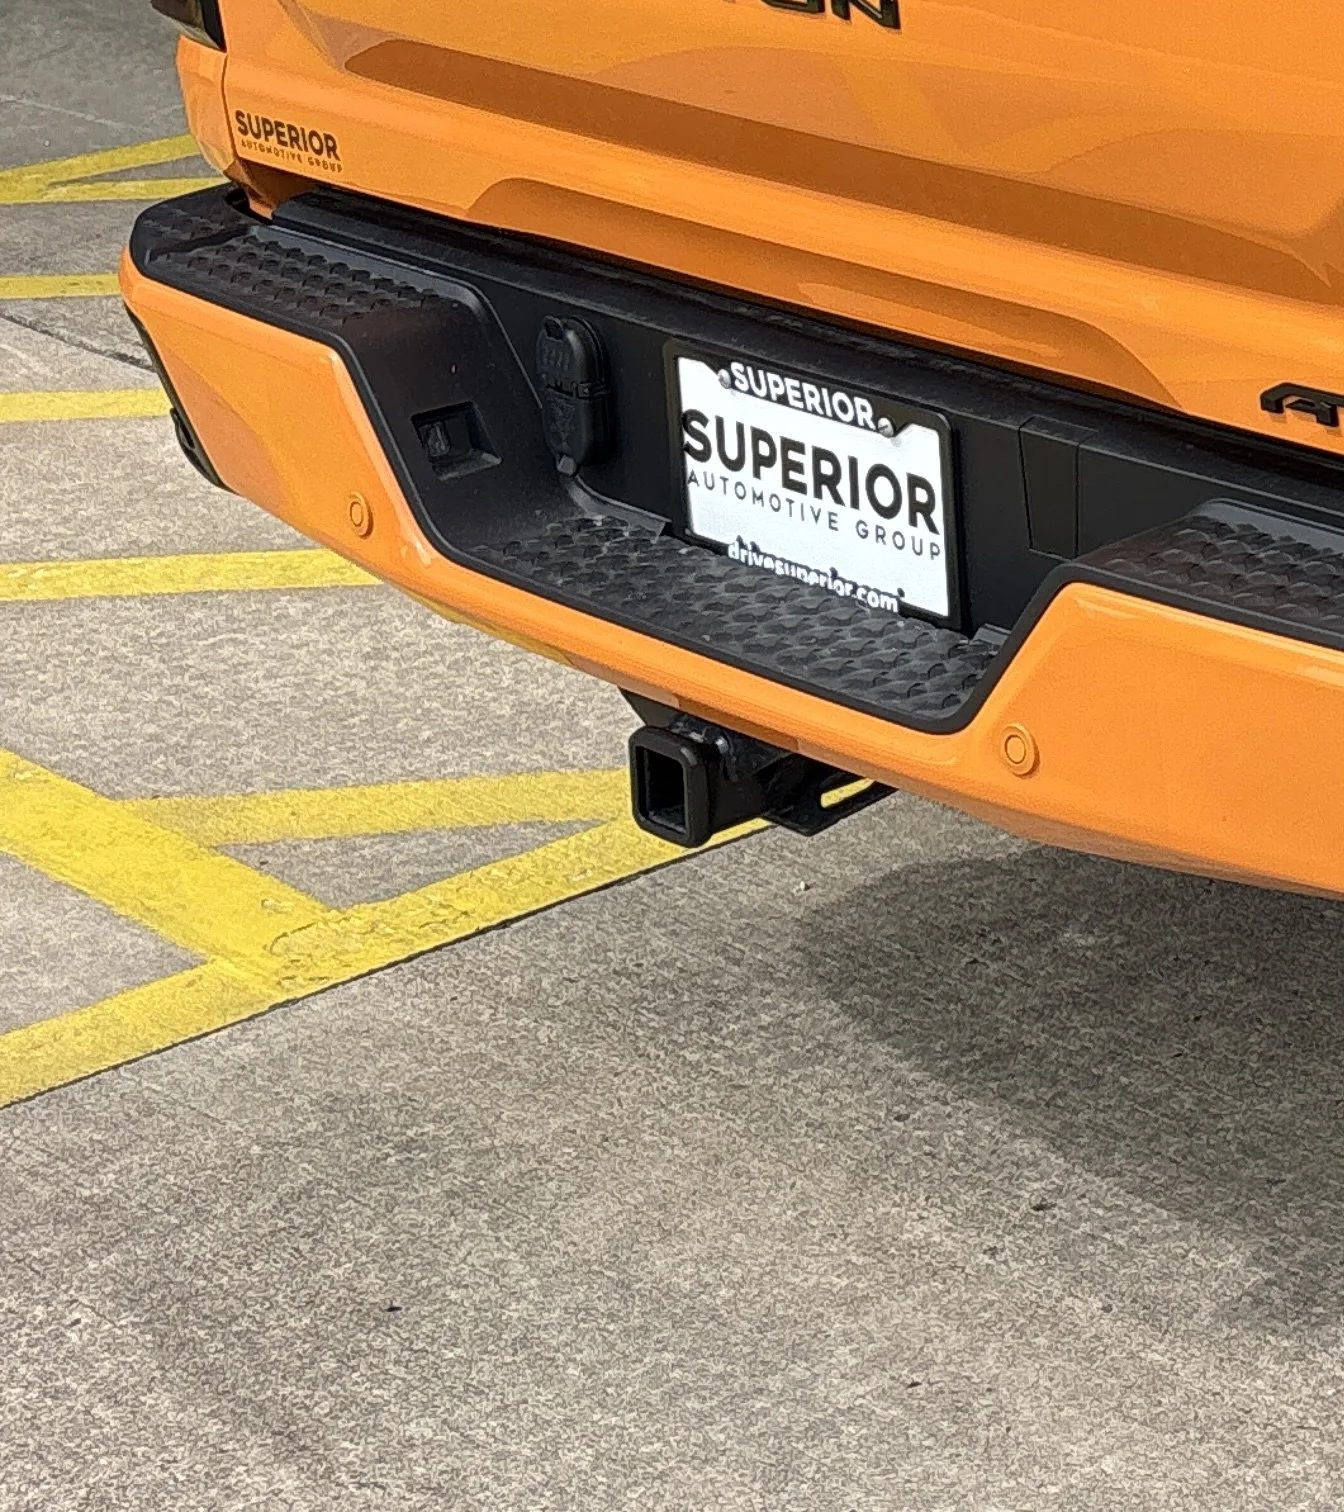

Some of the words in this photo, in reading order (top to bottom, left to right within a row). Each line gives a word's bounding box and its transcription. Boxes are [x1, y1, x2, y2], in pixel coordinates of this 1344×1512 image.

[235, 109, 341, 161] SUPERIOR
[730, 361, 876, 431] SUPERIOR
[682, 408, 940, 535] SUPERIOR
[687, 469, 839, 531] AUTOMOTIVE
[856, 519, 941, 561] GROUP
[728, 537, 899, 613] drivesuperior.com
